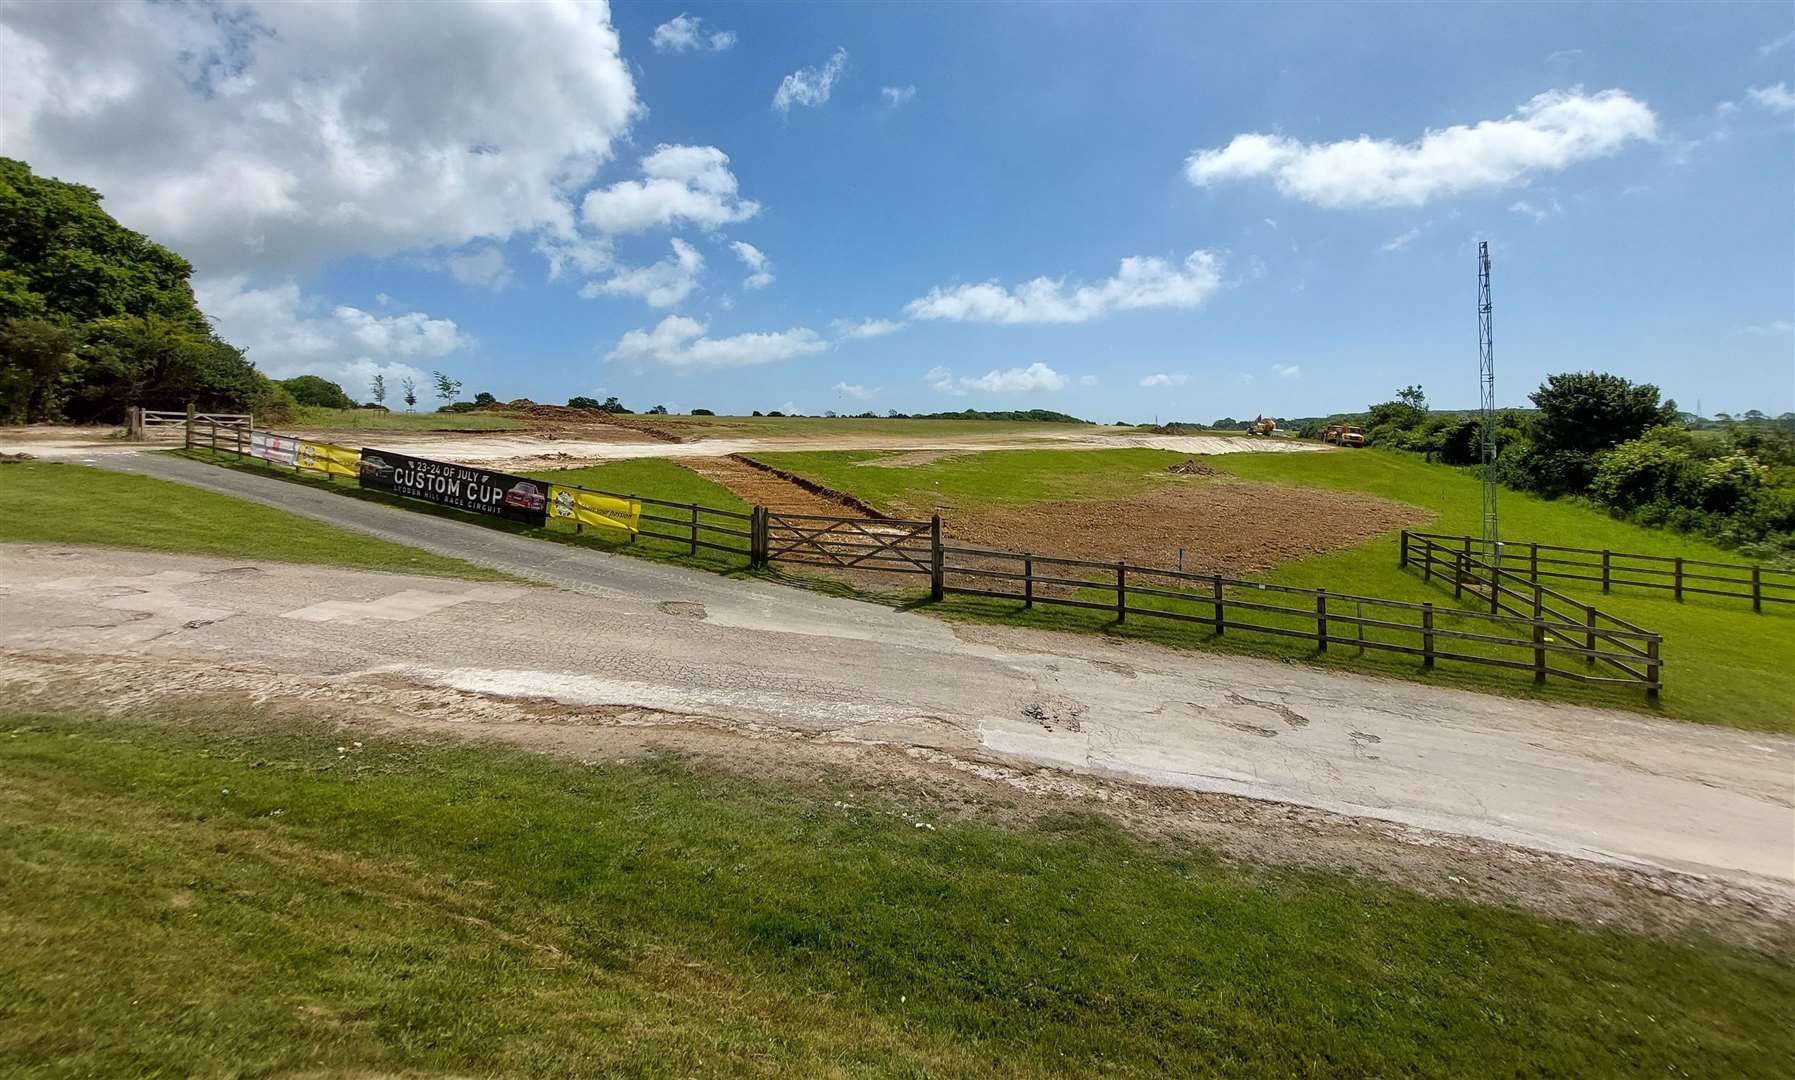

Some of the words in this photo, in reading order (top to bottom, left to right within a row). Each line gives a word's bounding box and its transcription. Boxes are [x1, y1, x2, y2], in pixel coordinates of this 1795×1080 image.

[417, 461, 441, 474] 23-24
[443, 466, 455, 477] OF
[457, 468, 479, 482] JULY
[394, 468, 460, 496] CUSTOM
[466, 483, 503, 505] CUP
[424, 491, 440, 501] HILL
[444, 495, 464, 506] RACE
[467, 501, 502, 514] CIRCUIT
